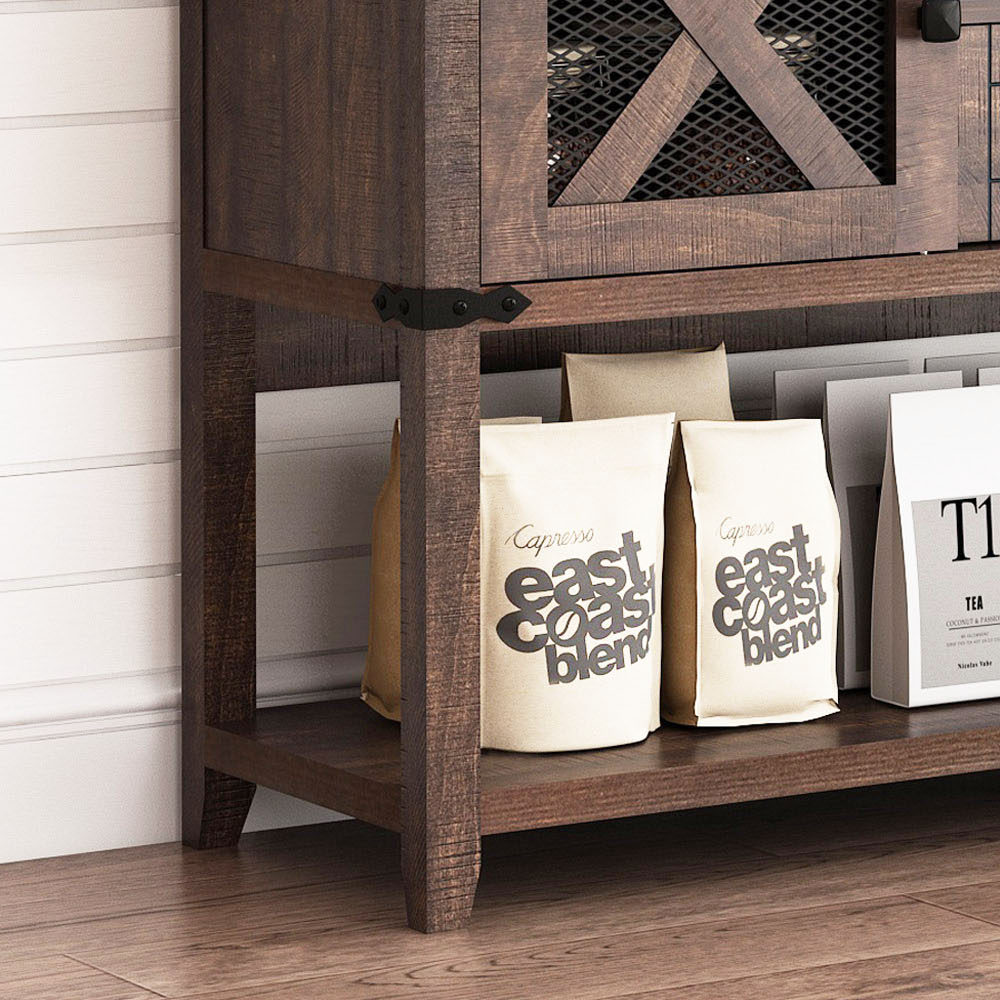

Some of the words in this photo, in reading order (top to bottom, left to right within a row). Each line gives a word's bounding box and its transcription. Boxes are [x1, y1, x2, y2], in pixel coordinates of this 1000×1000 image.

[504, 523, 594, 558] Capresso
[715, 523, 811, 598] east
[941, 494, 1000, 562] T1
[504, 530, 643, 612] east
[712, 555, 827, 637] coast
[965, 595, 984, 612] TEA
[545, 615, 653, 685] blend
[741, 603, 822, 667] blend
